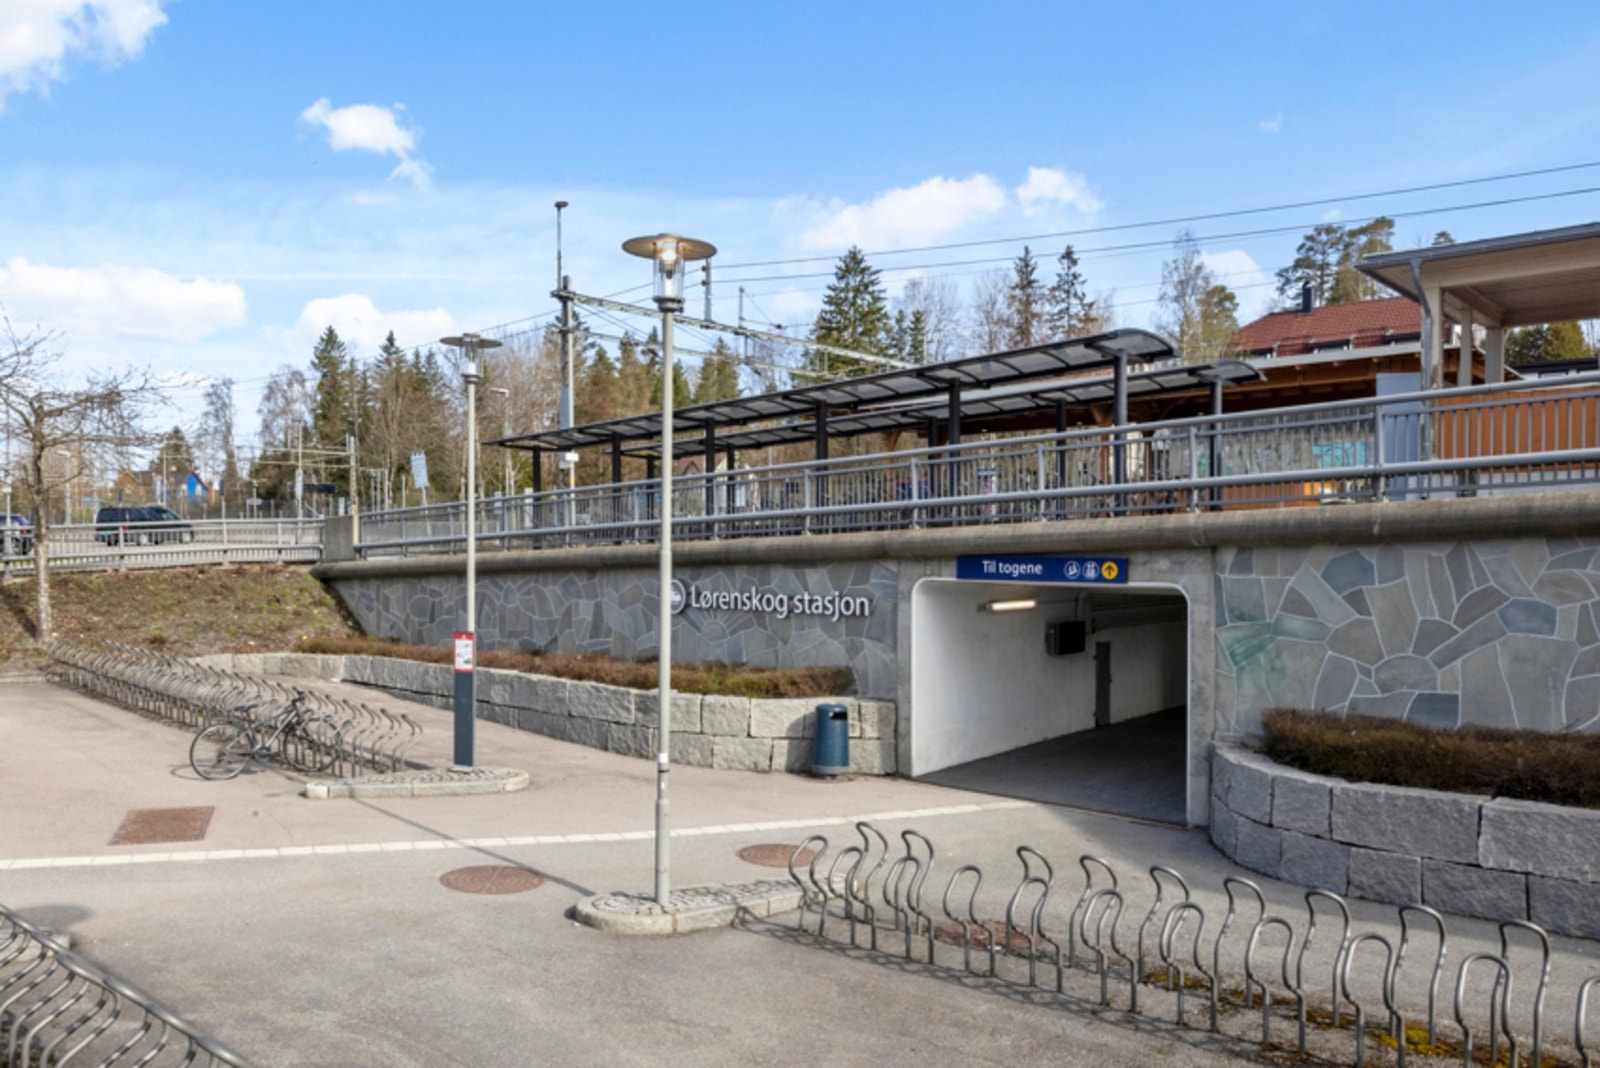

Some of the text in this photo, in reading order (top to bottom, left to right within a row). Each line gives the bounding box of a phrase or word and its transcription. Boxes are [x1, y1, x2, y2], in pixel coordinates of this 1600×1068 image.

[982, 560, 1043, 577] Til togene
[691, 585, 870, 622] Lørenskog stasjon
